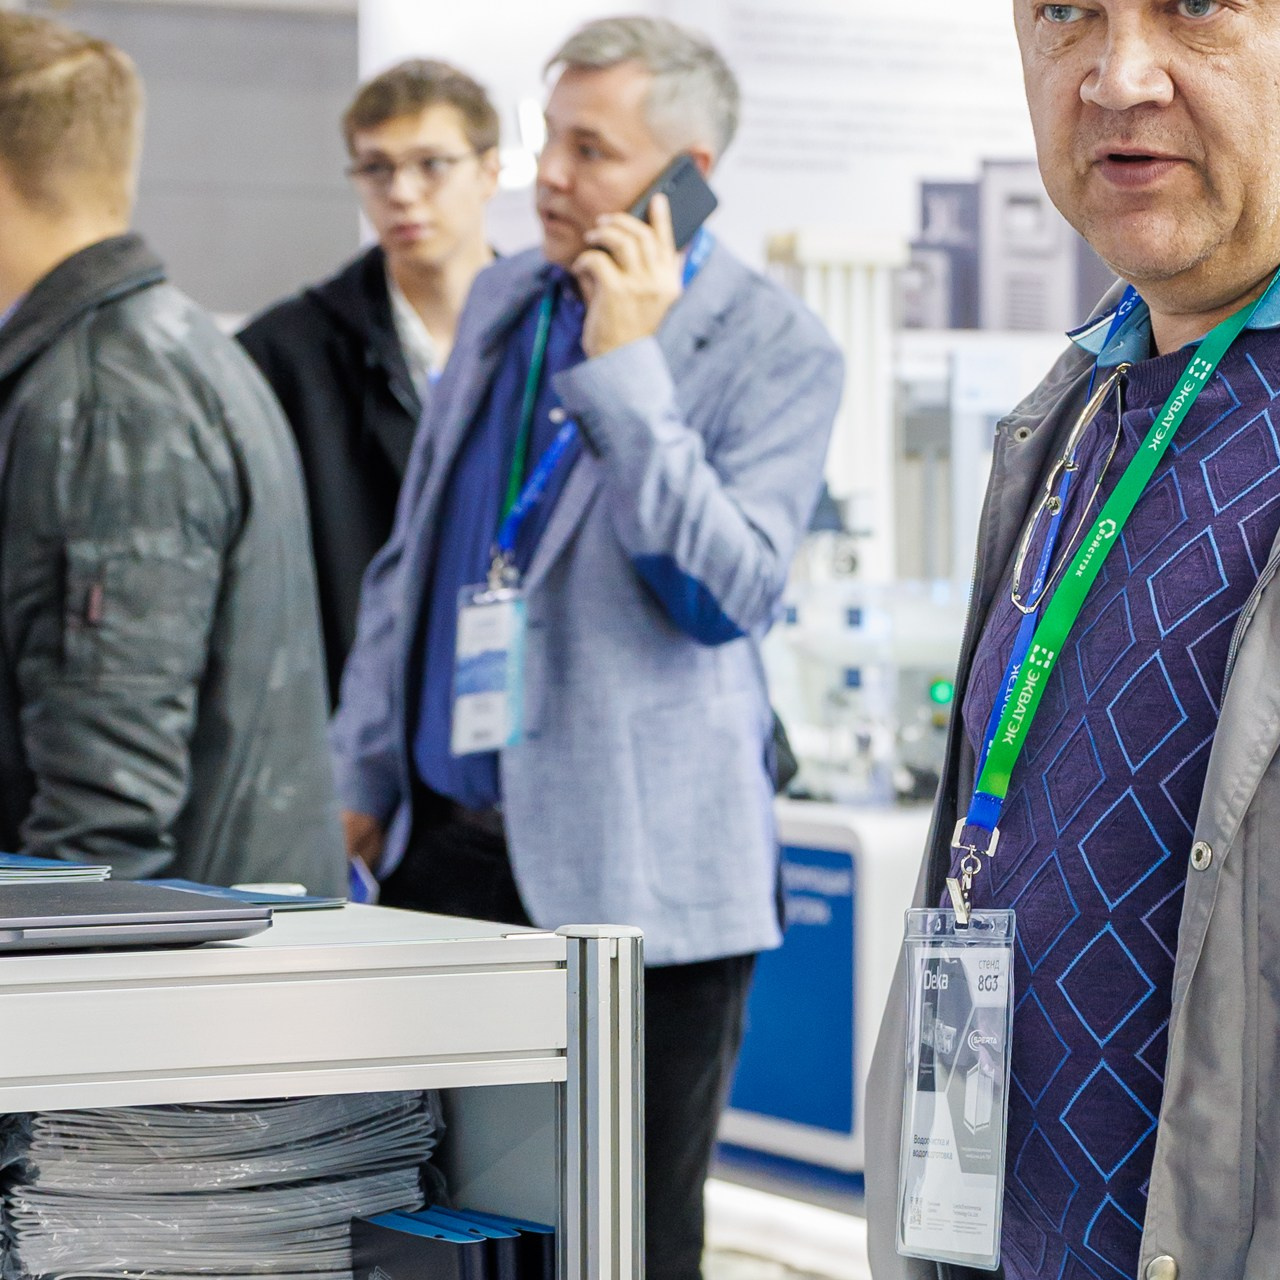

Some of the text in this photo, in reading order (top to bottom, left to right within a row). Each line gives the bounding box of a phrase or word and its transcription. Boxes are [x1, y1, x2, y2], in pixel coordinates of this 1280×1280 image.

[1148, 380, 1195, 451] ЭКВАТЭК
[1075, 528, 1106, 577] ВЭЙСТТЭК
[1002, 668, 1041, 745] ЭКВАТЭК
[924, 966, 949, 990] Deka
[978, 959, 1000, 970] стенд
